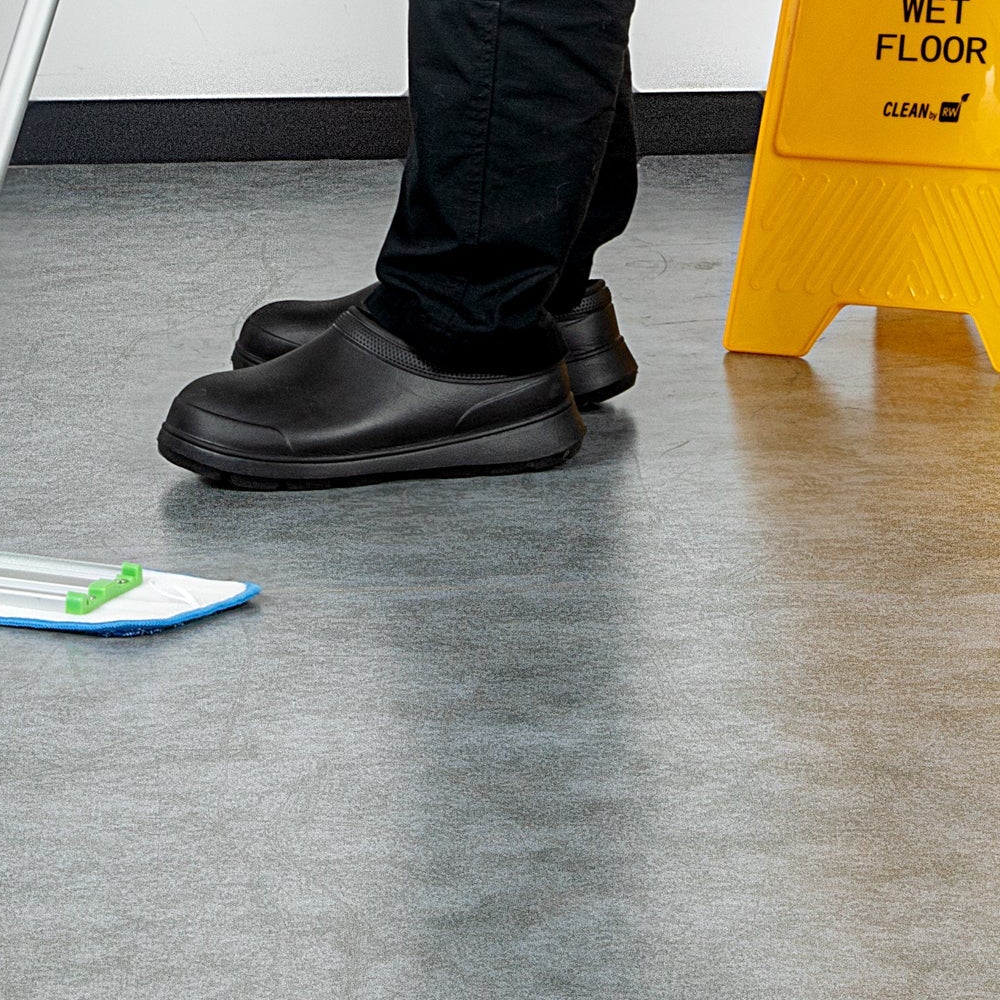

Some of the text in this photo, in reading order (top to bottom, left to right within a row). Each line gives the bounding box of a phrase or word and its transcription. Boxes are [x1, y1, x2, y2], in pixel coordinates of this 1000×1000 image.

[875, 33, 988, 65] FLOOR
[883, 101, 930, 119] CLEAN
[929, 111, 937, 121] by
